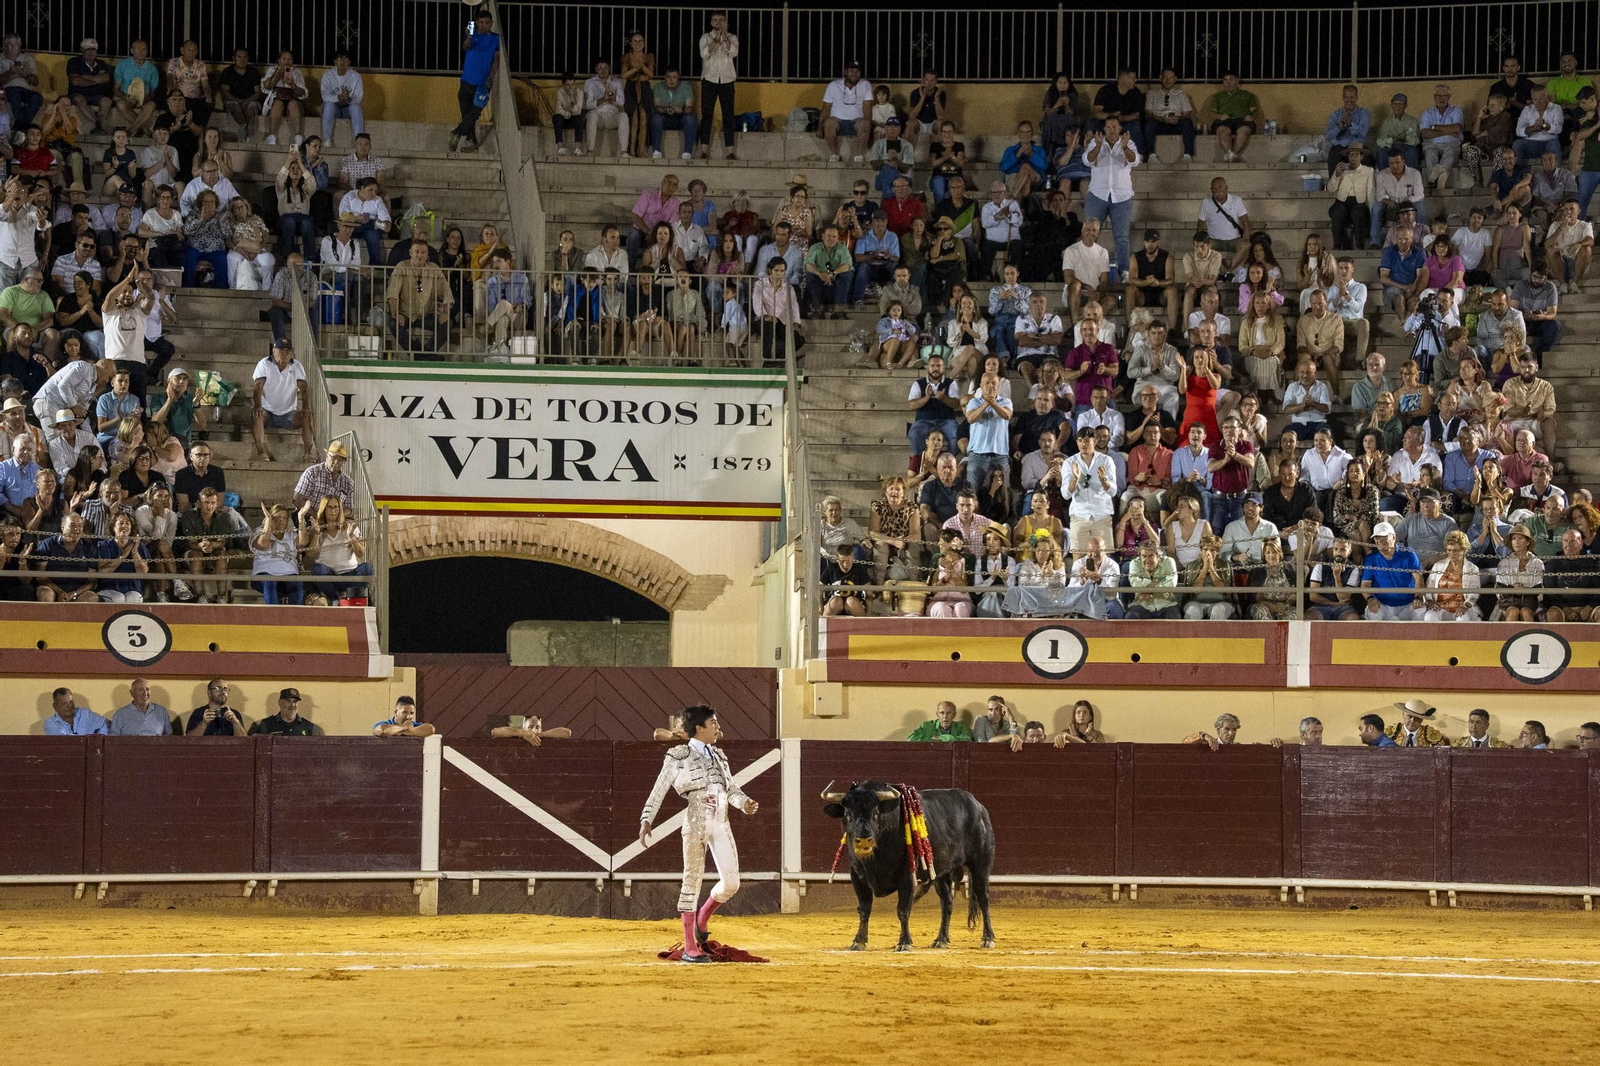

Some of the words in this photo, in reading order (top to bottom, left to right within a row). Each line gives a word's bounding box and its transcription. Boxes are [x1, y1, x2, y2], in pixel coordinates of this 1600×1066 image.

[472, 397, 532, 422] DE
[547, 398, 699, 424] TOROS
[713, 402, 773, 427] DE
[428, 436, 660, 482] VERA
[712, 457, 773, 471] 1879
[128, 626, 147, 647] 5
[1048, 640, 1059, 659] 1
[1528, 645, 1539, 664] 1
